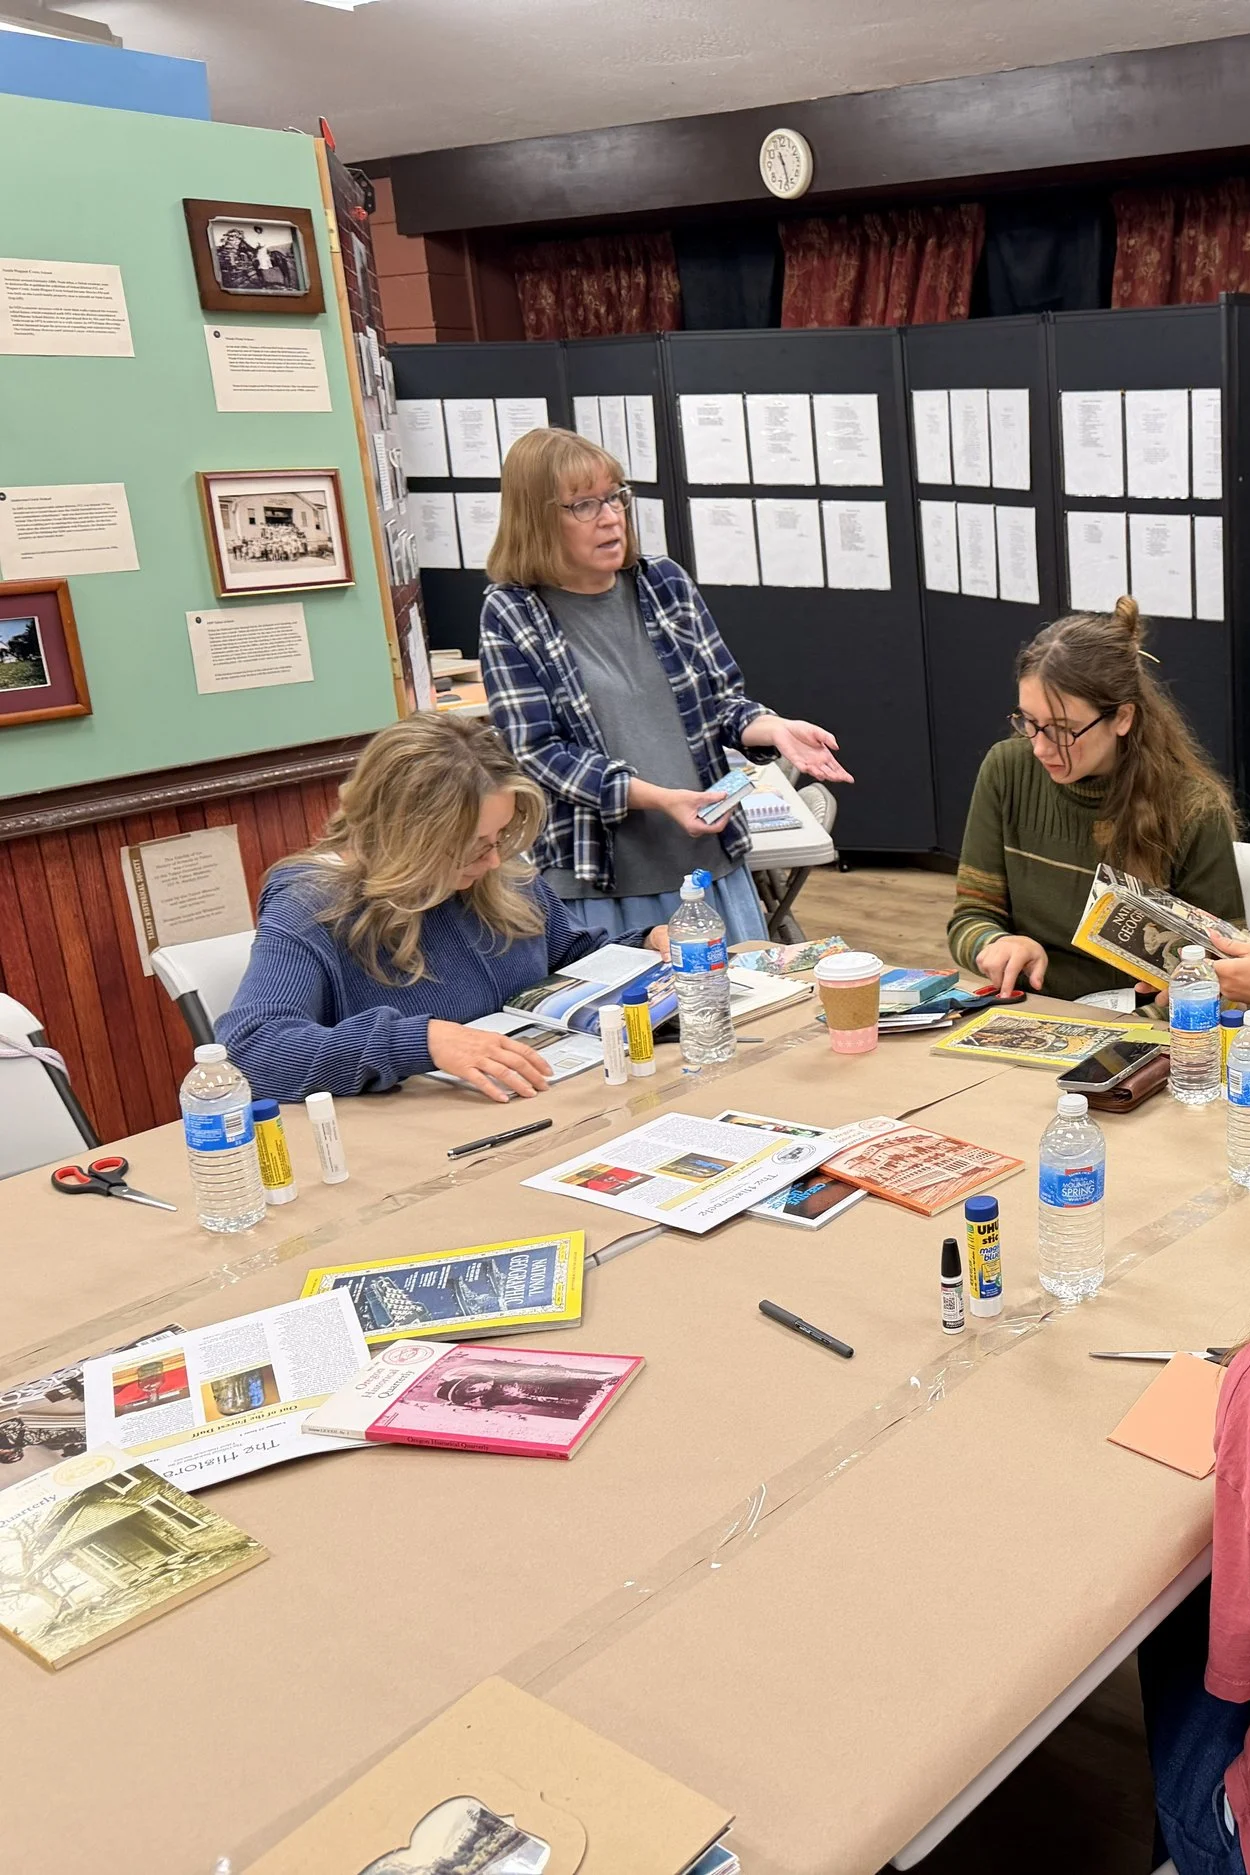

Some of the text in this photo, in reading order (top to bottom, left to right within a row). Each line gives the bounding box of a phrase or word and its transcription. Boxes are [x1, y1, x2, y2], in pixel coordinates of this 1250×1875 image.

[754, 1172, 779, 1189] The
[1062, 1179, 1095, 1188] MOUNTAIN
[1061, 1184, 1095, 1197] SPRING
[977, 1219, 999, 1235] UHU
[504, 1254, 530, 1306] GEOGRAPHIC
[528, 1258, 548, 1297] NATIONAL
[355, 1368, 386, 1390] Oregon
[378, 1370, 415, 1398] Quarterly
[244, 1439, 280, 1454] The
[406, 1436, 429, 1447] Oregon
[460, 1441, 489, 1452] Quarterly
